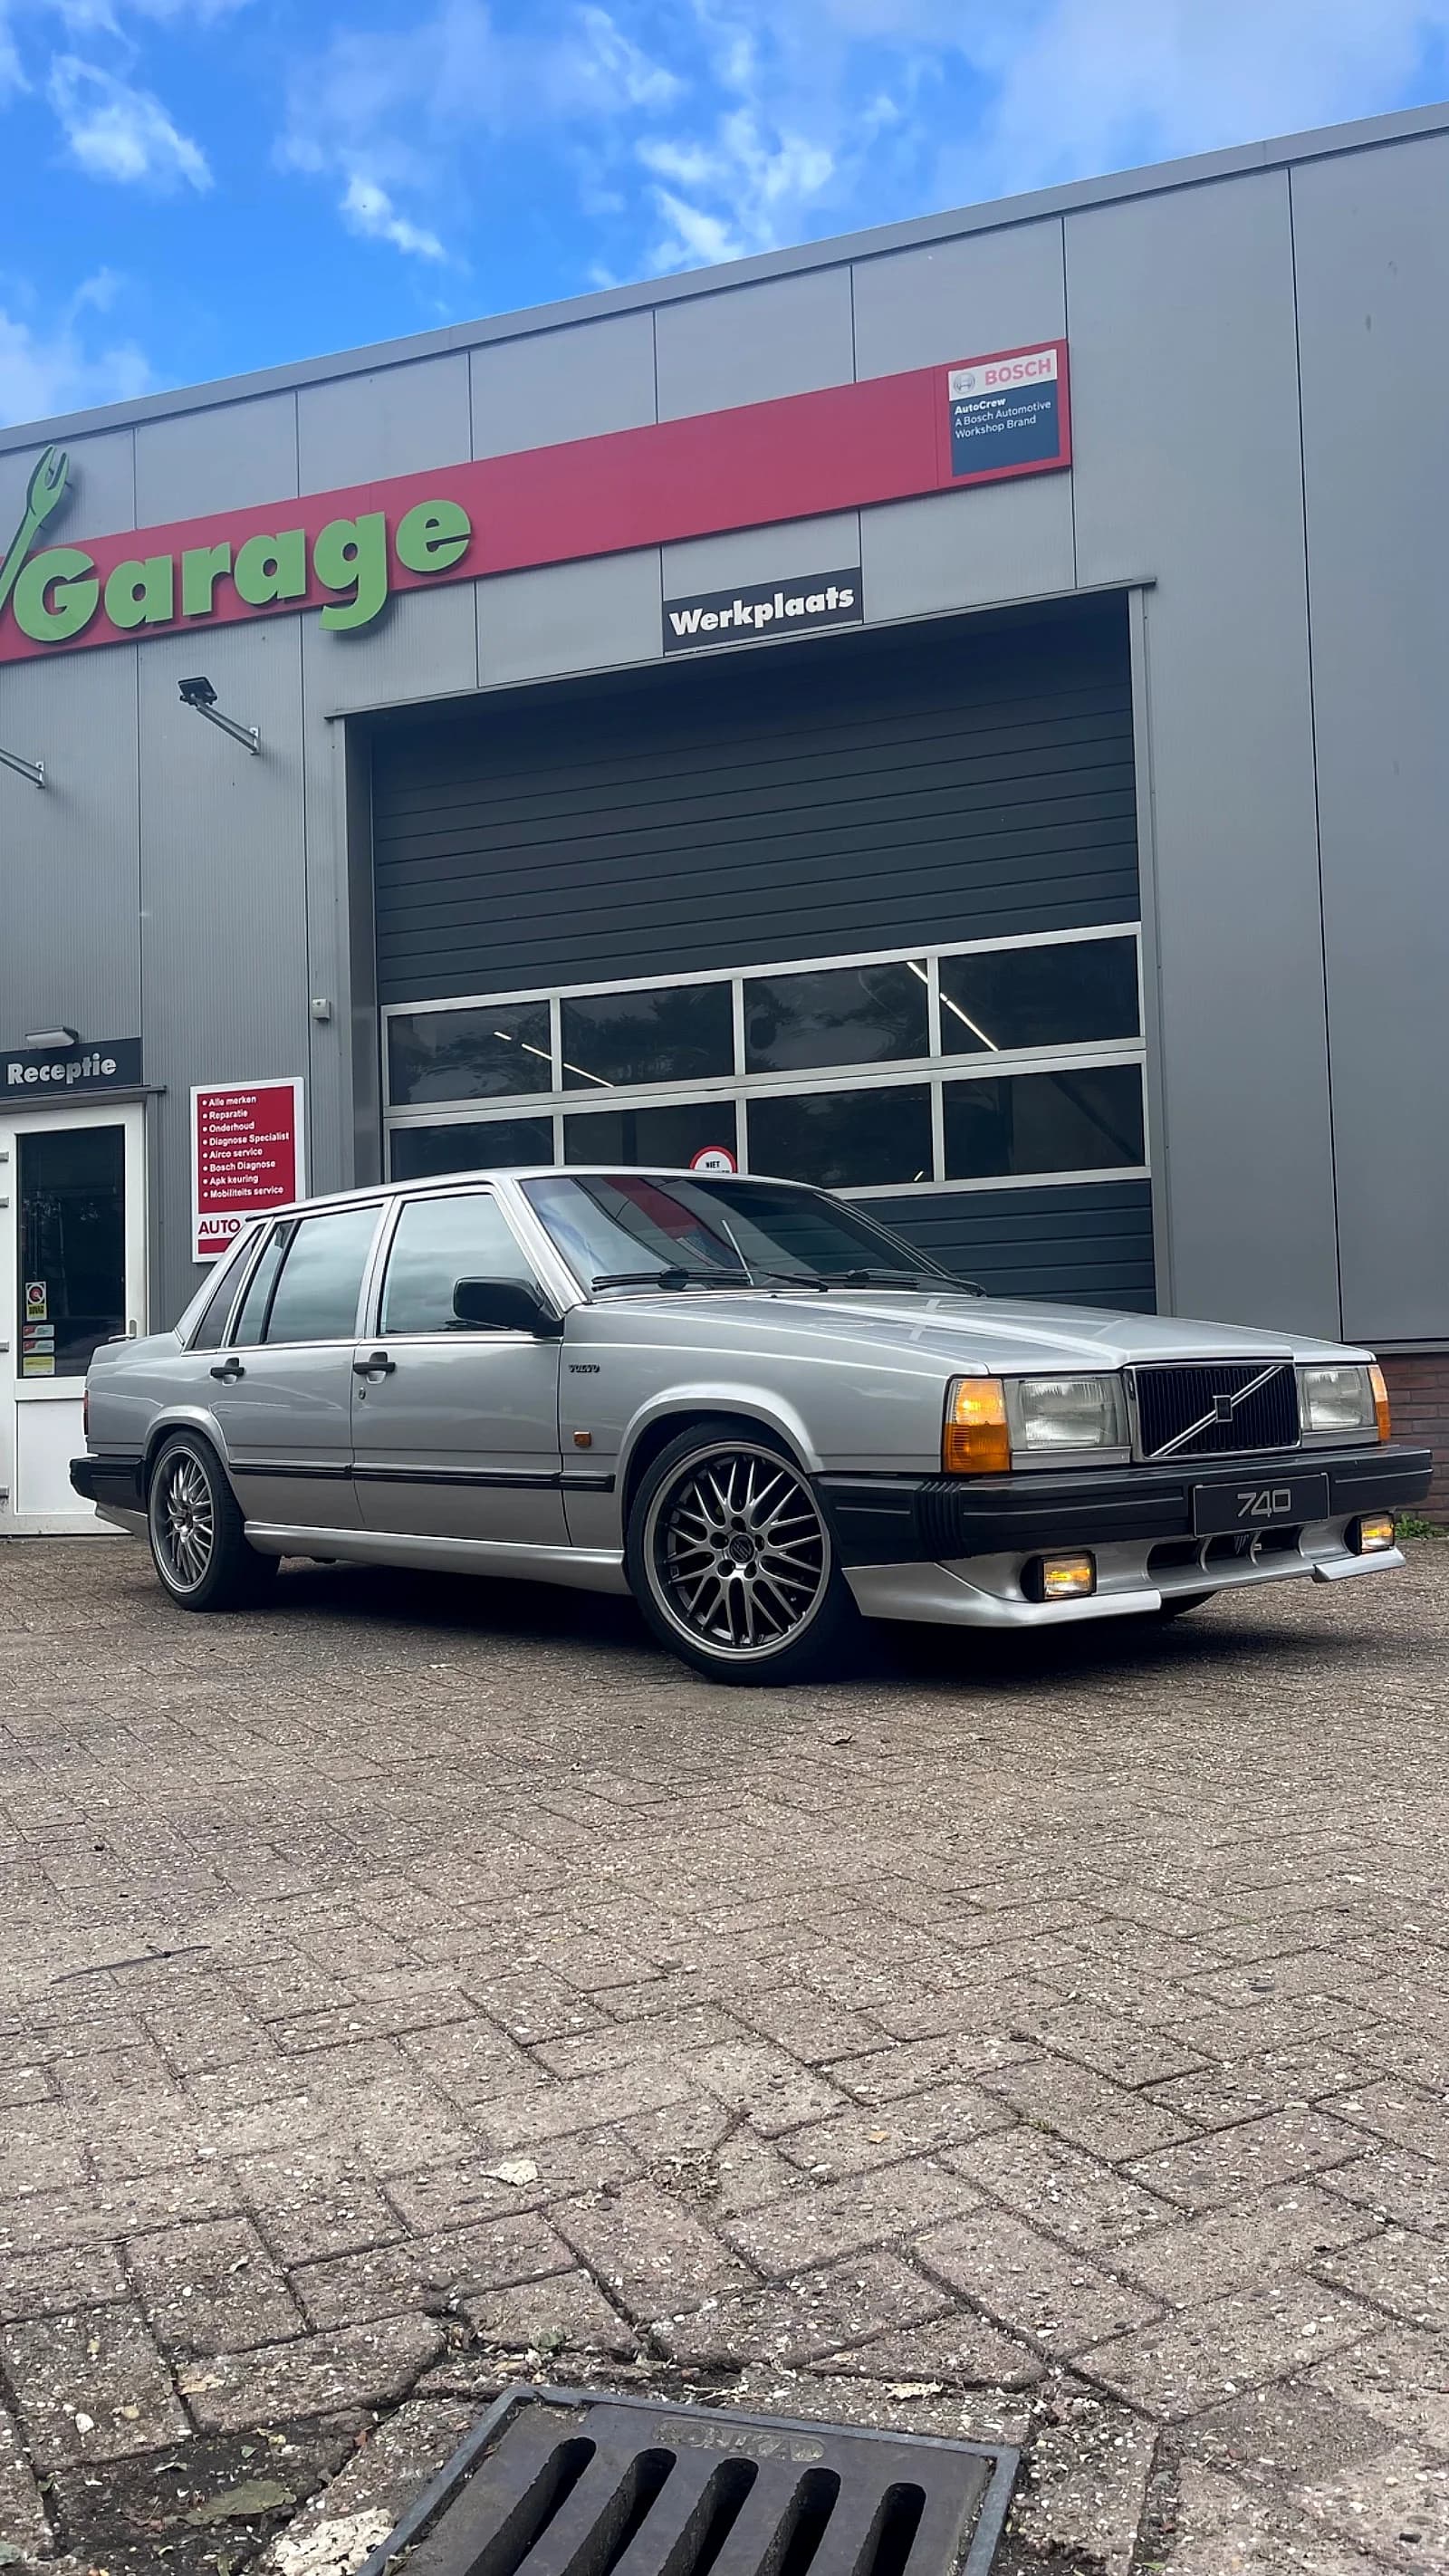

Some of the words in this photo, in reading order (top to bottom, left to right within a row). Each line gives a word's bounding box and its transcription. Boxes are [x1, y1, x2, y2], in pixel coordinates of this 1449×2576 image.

[984, 358, 1051, 386] BOSCH
[954, 398, 1007, 416] AutoCrew
[955, 418, 963, 428] A
[964, 411, 994, 425] Bosch
[995, 400, 1051, 419] Automotive
[955, 421, 1005, 440] Workshop
[1006, 414, 1037, 429] Brand
[12, 499, 472, 642] Garage
[668, 586, 855, 636] Werkplaats
[6, 1053, 117, 1085] Receptie
[209, 1098, 225, 1107] Alle
[226, 1096, 257, 1105] merken
[209, 1109, 249, 1120] Reparatie
[209, 1121, 255, 1132] Onderhoud
[209, 1136, 247, 1148] Diagnose
[249, 1131, 290, 1144] Specialist
[209, 1150, 232, 1159] Airco
[233, 1148, 263, 1158] service
[209, 1163, 236, 1172] Bosch
[237, 1160, 275, 1171] Diagnose
[209, 1177, 226, 1187] Apk
[227, 1175, 259, 1184] keuring
[210, 1187, 253, 1198] Mobiliteits
[254, 1186, 284, 1196] service
[1237, 1488, 1291, 1518] 740
